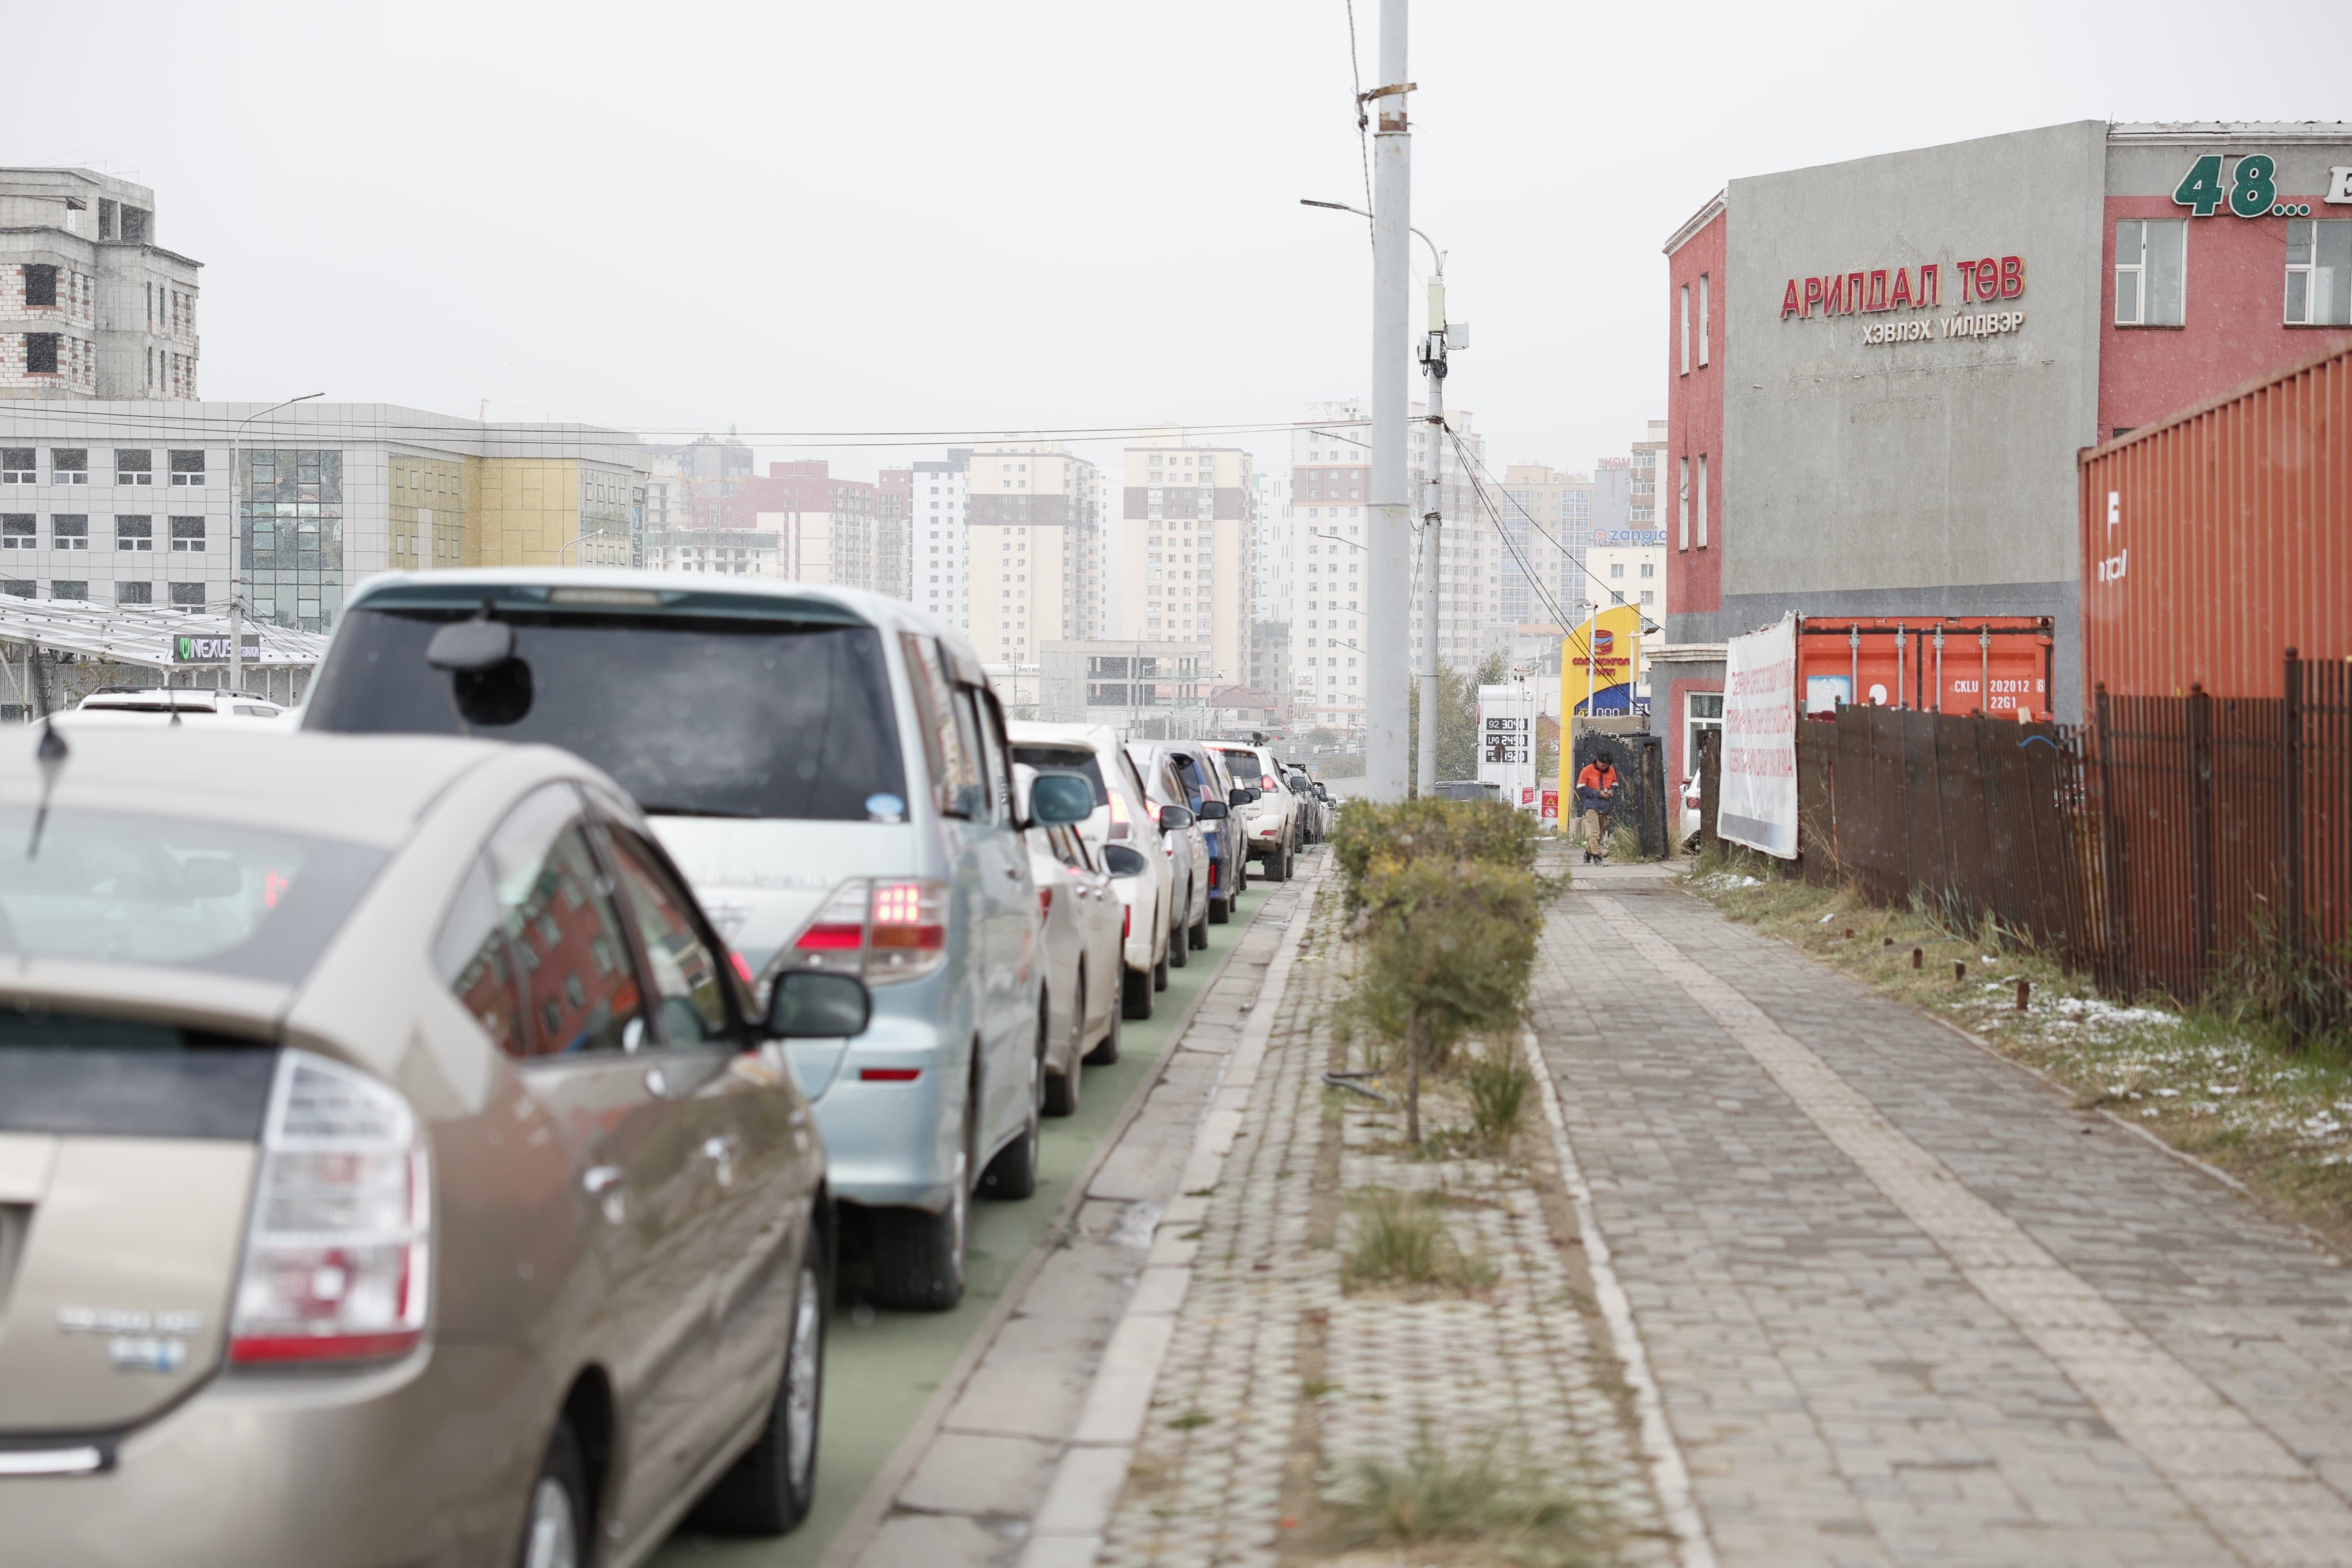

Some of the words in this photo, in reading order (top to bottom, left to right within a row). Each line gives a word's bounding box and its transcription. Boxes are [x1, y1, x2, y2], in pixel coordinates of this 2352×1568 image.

[1780, 264, 1942, 320] АРИЛДАЛ
[1956, 255, 2026, 303] ТӨВ
[1862, 319, 1934, 344] ХЭВЛЭХ
[1940, 309, 2025, 339] ҮЙЛДВЭР
[1955, 680, 1979, 692] CKLU
[1990, 680, 2029, 692] 202012
[2036, 679, 2045, 692] 6
